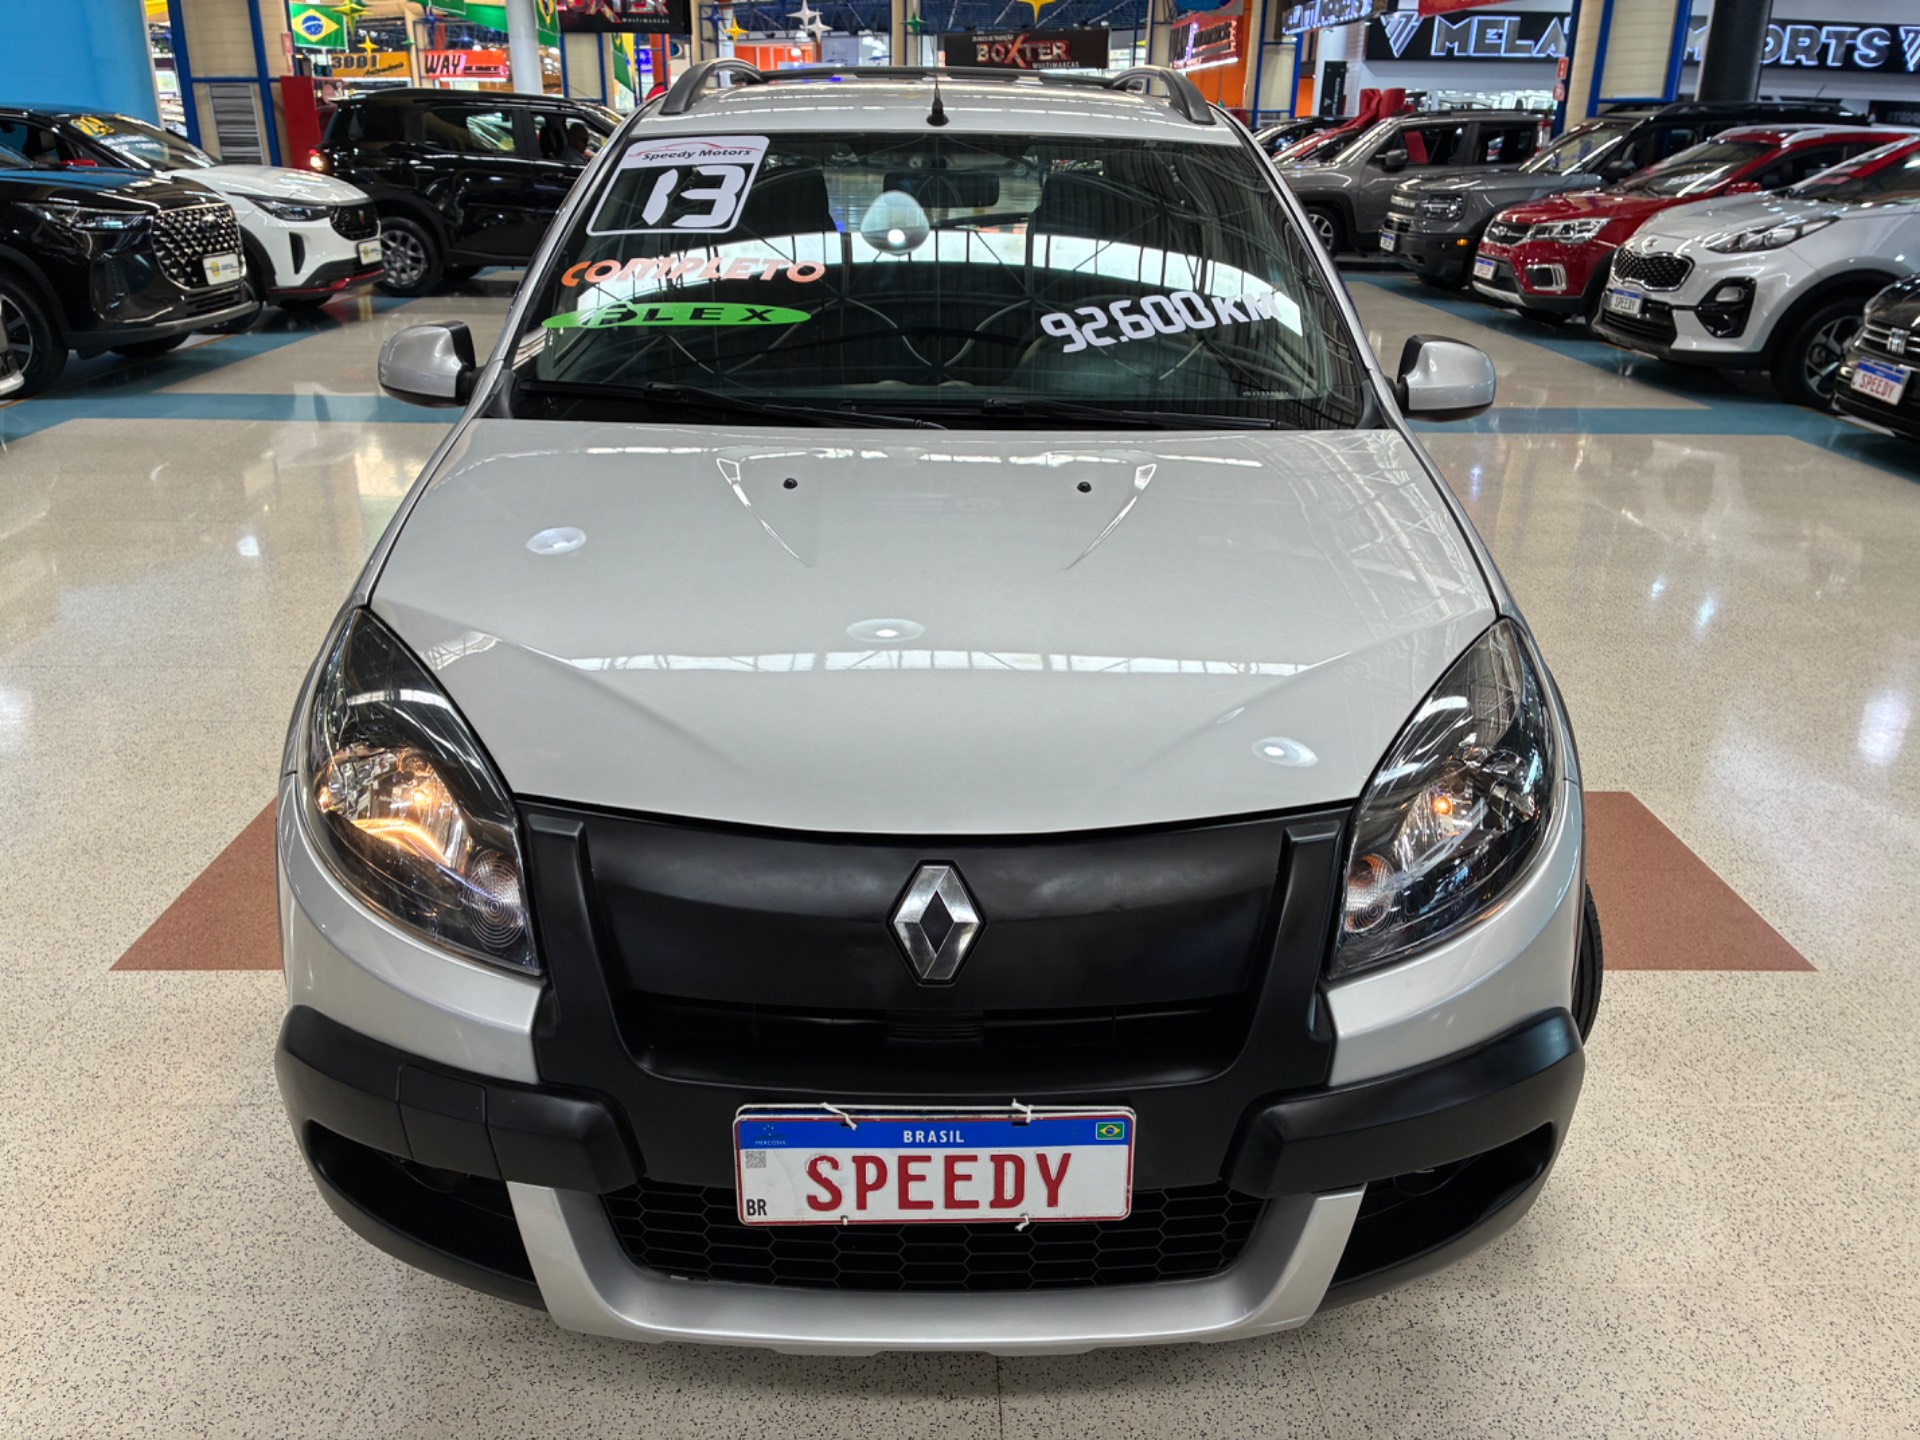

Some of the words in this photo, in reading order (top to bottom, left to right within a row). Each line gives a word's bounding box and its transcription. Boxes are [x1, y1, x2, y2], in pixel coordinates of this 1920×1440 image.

[975, 33, 1069, 68] BOXTER
[425, 55, 462, 75] WAY
[642, 150, 695, 161] Speedy
[698, 149, 752, 158] Motors
[641, 164, 746, 228] 13
[561, 256, 826, 287] COMPLETO
[1859, 373, 1896, 399] SPEEDY
[903, 1129, 965, 1144] BRASIL
[806, 1152, 1072, 1211] SPEEDY
[746, 1199, 768, 1217] BR
